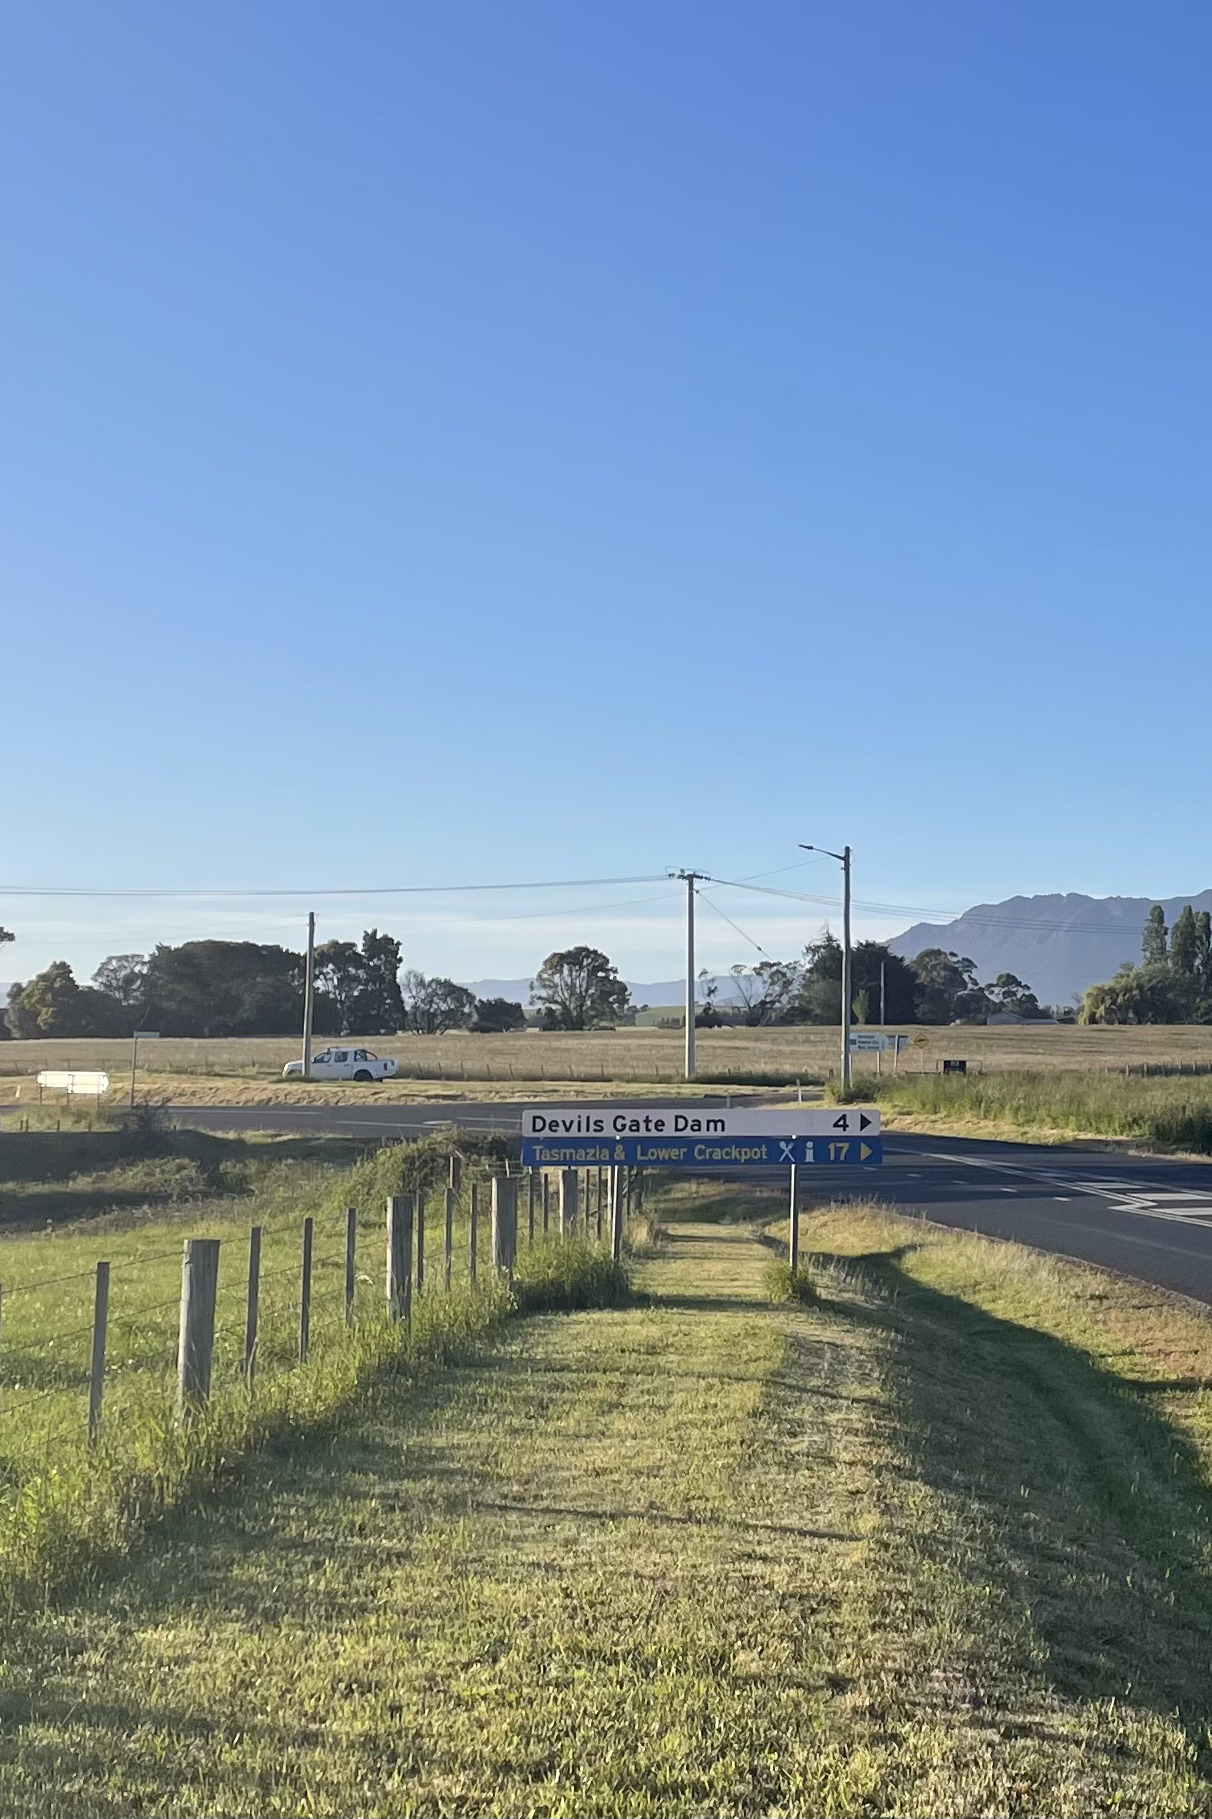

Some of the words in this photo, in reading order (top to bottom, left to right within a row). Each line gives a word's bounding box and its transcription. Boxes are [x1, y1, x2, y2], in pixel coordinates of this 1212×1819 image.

[531, 1114, 605, 1133] Devils
[612, 1114, 666, 1133] Gate
[674, 1114, 726, 1133] Dam
[832, 1113, 850, 1132] 4
[532, 1144, 610, 1161] Tasmazia
[614, 1144, 626, 1161] &
[636, 1144, 688, 1161] Lower
[693, 1143, 768, 1163] Crackpot
[828, 1142, 850, 1161] 17
